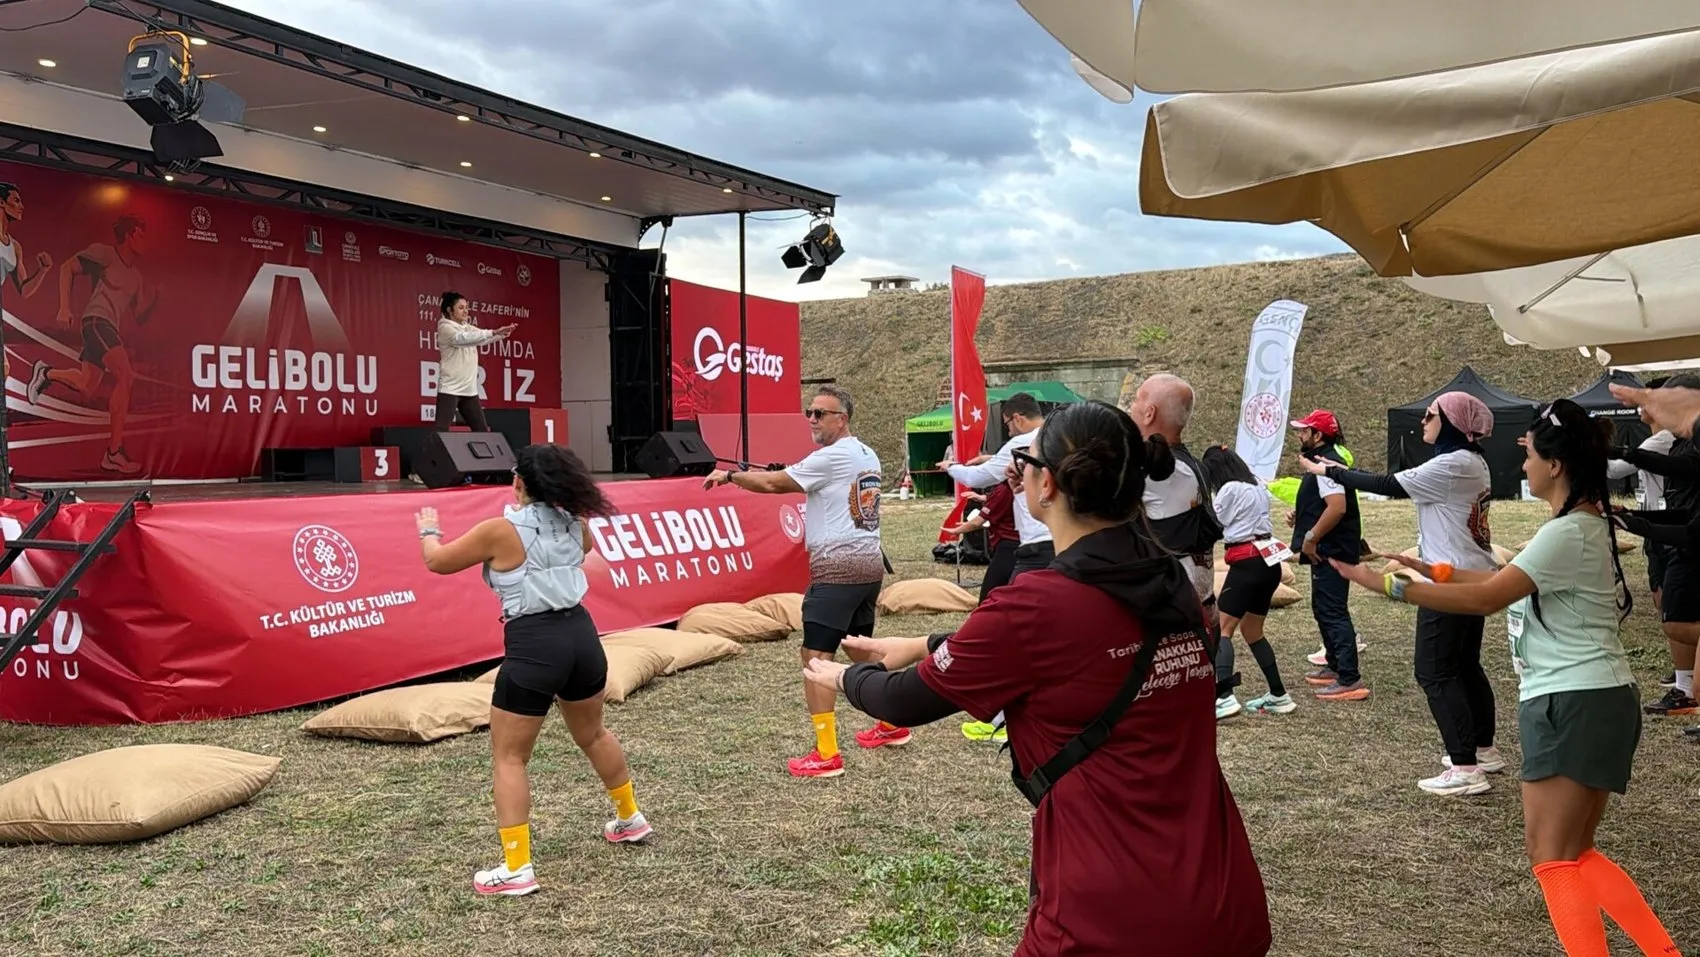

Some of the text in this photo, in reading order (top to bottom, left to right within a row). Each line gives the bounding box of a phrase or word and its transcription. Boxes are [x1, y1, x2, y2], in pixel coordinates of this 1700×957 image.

[418, 294, 478, 312] ÇANLE
[419, 330, 535, 360] HE DIMDA
[420, 359, 536, 402] BR İZ
[191, 394, 378, 416] MARATONU
[544, 419, 554, 443] 1
[374, 449, 389, 477] 3
[609, 551, 754, 589] MARATONU
[259, 590, 416, 630] T.C. KÜLTÜR VE TURİZM
[308, 611, 385, 639] BAKANLIĞI
[1154, 653, 1201, 676] RUHUNU
